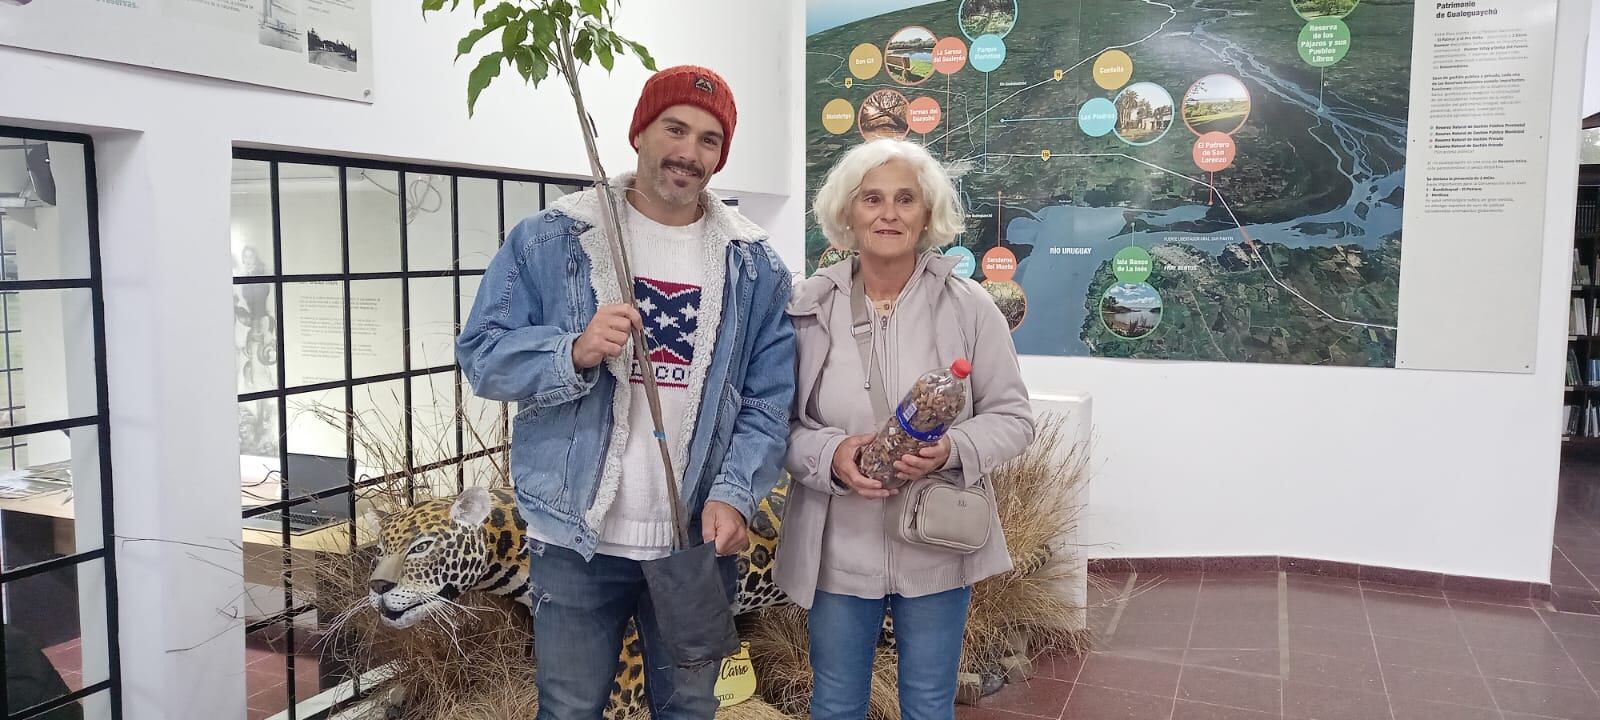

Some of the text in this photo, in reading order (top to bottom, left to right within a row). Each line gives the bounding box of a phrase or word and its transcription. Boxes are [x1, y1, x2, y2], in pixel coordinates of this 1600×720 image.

[1436, 0, 1476, 9] Patrimonio
[1061, 247, 1093, 255] URUGUAY
[721, 660, 749, 680] Carro
